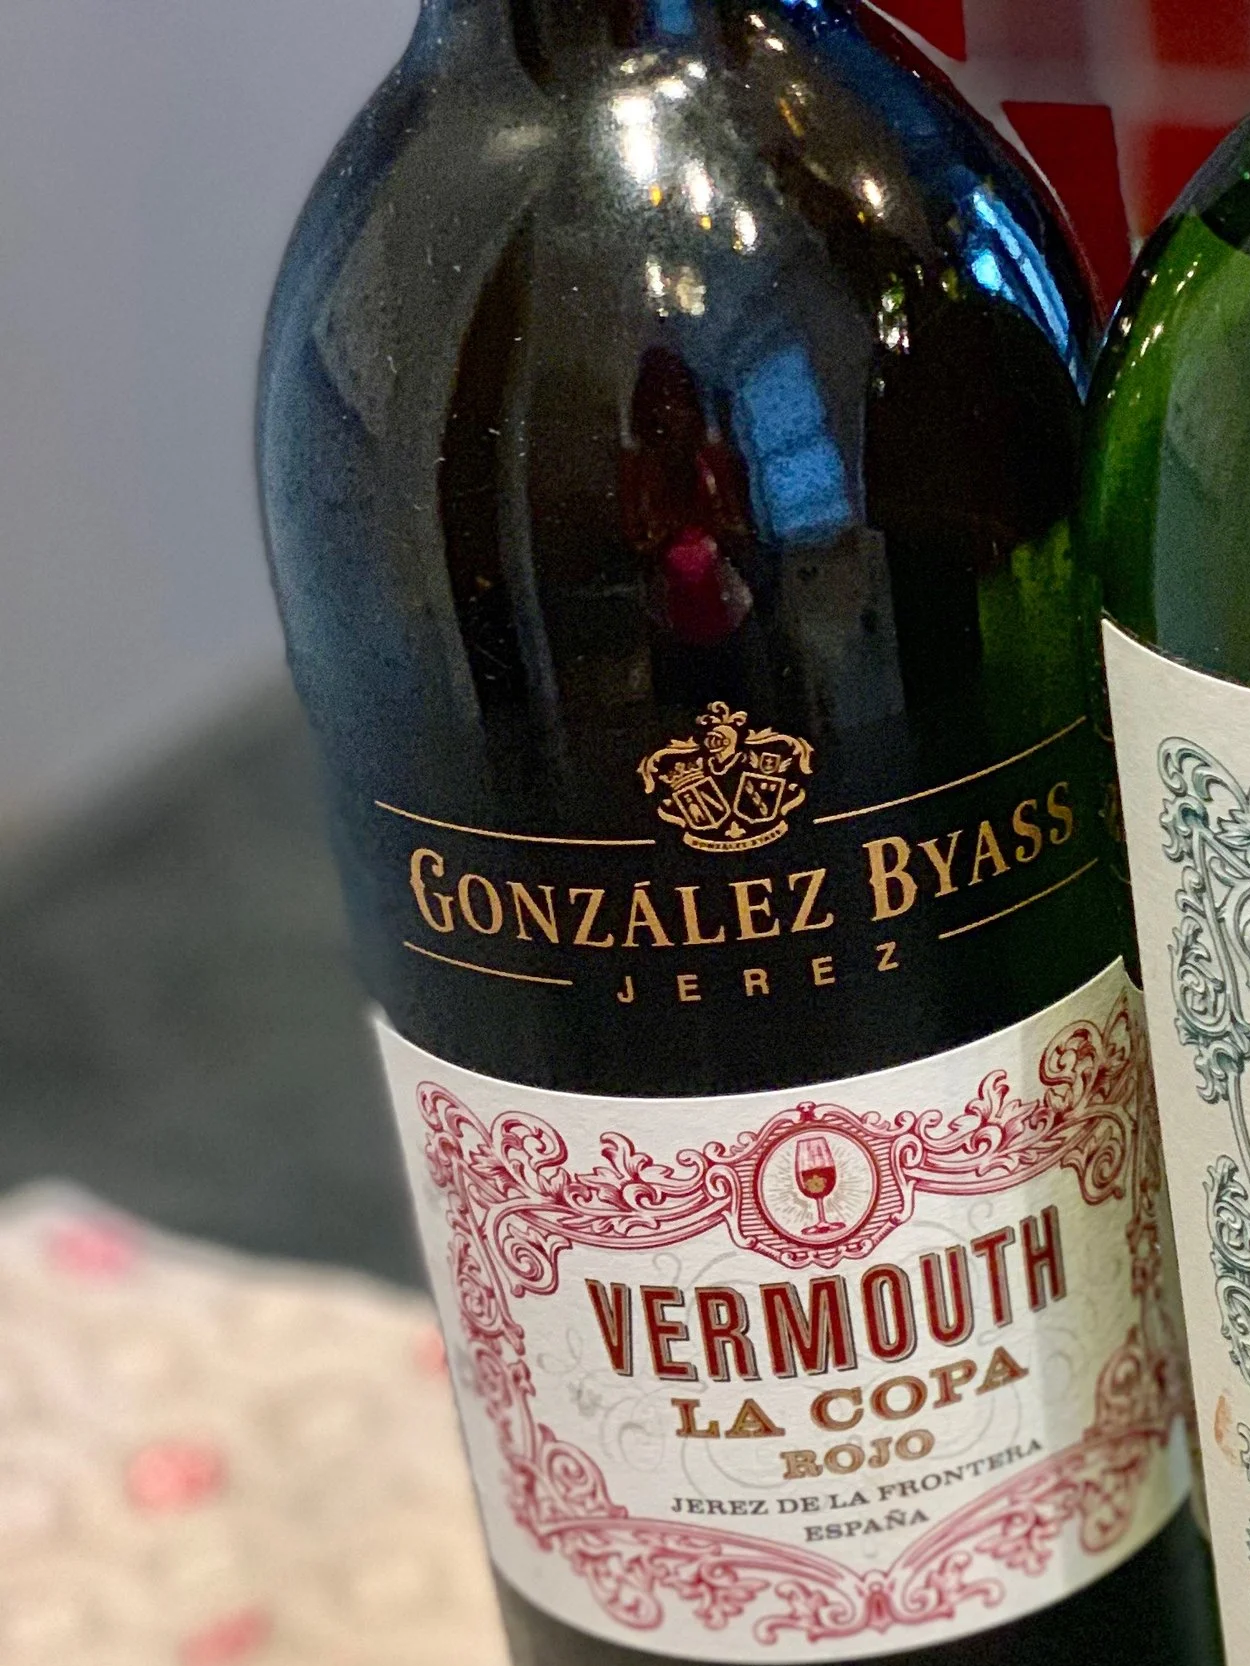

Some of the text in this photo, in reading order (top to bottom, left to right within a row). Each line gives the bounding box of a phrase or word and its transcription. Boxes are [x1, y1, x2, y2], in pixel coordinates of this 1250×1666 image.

[409, 781, 1075, 948] GONZÁLEZ BYASS
[617, 944, 899, 1003] JEREZ
[585, 1206, 1068, 1382] VERMOUTH
[671, 1346, 1028, 1440] LA COPA
[671, 1438, 1043, 1516] JEREZ DE LA FRONTERA
[780, 1429, 935, 1480] ROJO
[804, 1507, 931, 1544] ESPAÑA
